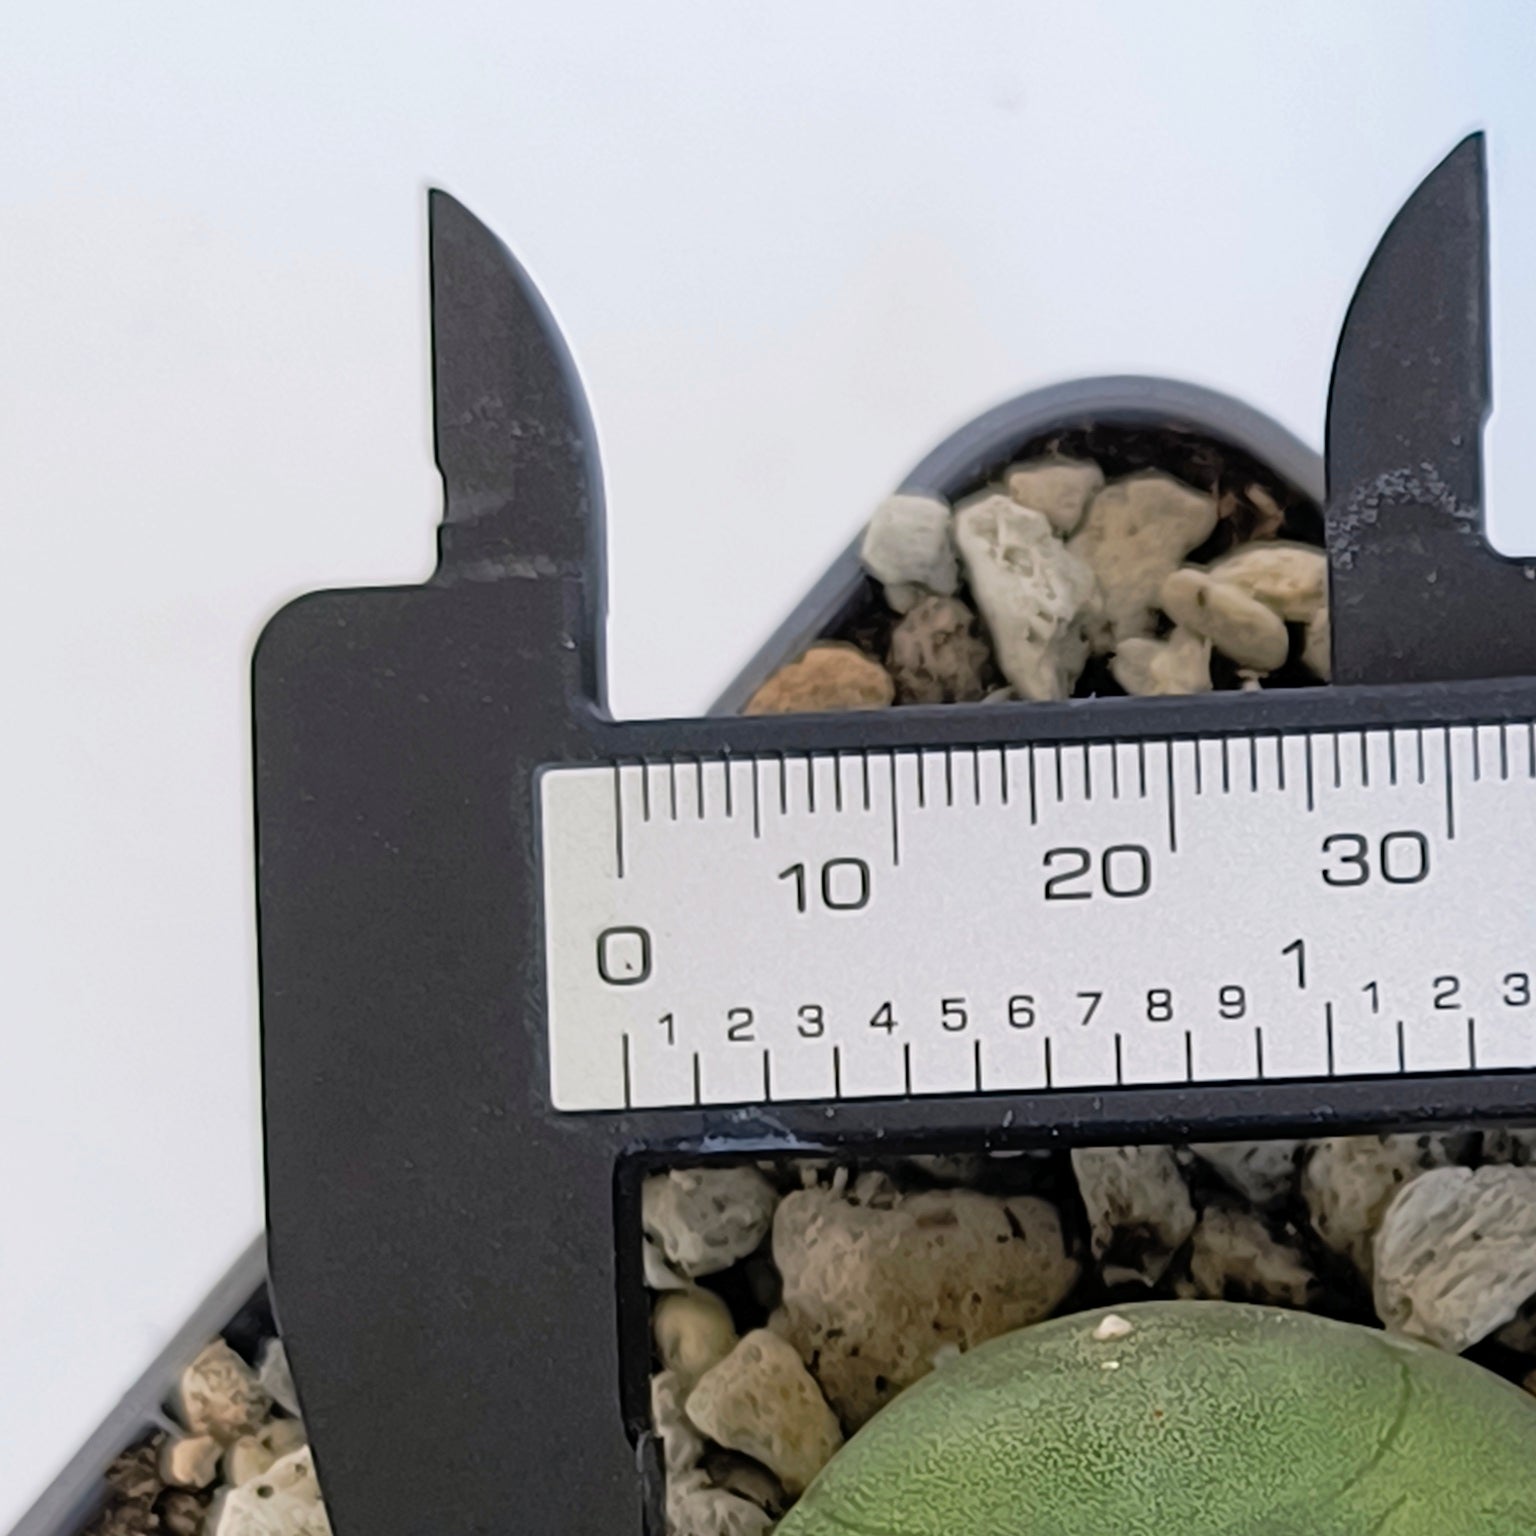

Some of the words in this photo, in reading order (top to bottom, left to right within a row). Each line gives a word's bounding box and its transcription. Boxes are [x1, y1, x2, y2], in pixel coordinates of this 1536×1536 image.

[778, 857, 871, 914] 10
[1042, 844, 1151, 900] 20
[1321, 830, 1430, 887] 30
[596, 925, 652, 986] 0
[1281, 938, 1307, 990] 1
[657, 1013, 675, 1047] 1
[726, 1007, 755, 1042] 2
[797, 1004, 825, 1039] 3
[869, 1000, 898, 1036] 4
[940, 997, 969, 1032] 5
[1008, 994, 1036, 1029] 6
[1076, 992, 1104, 1027] 7
[1146, 988, 1175, 1022] 8
[1218, 984, 1247, 1019] 9
[1361, 980, 1379, 1014] 1
[1432, 976, 1461, 1010] 2
[1502, 973, 1531, 1007] 3
